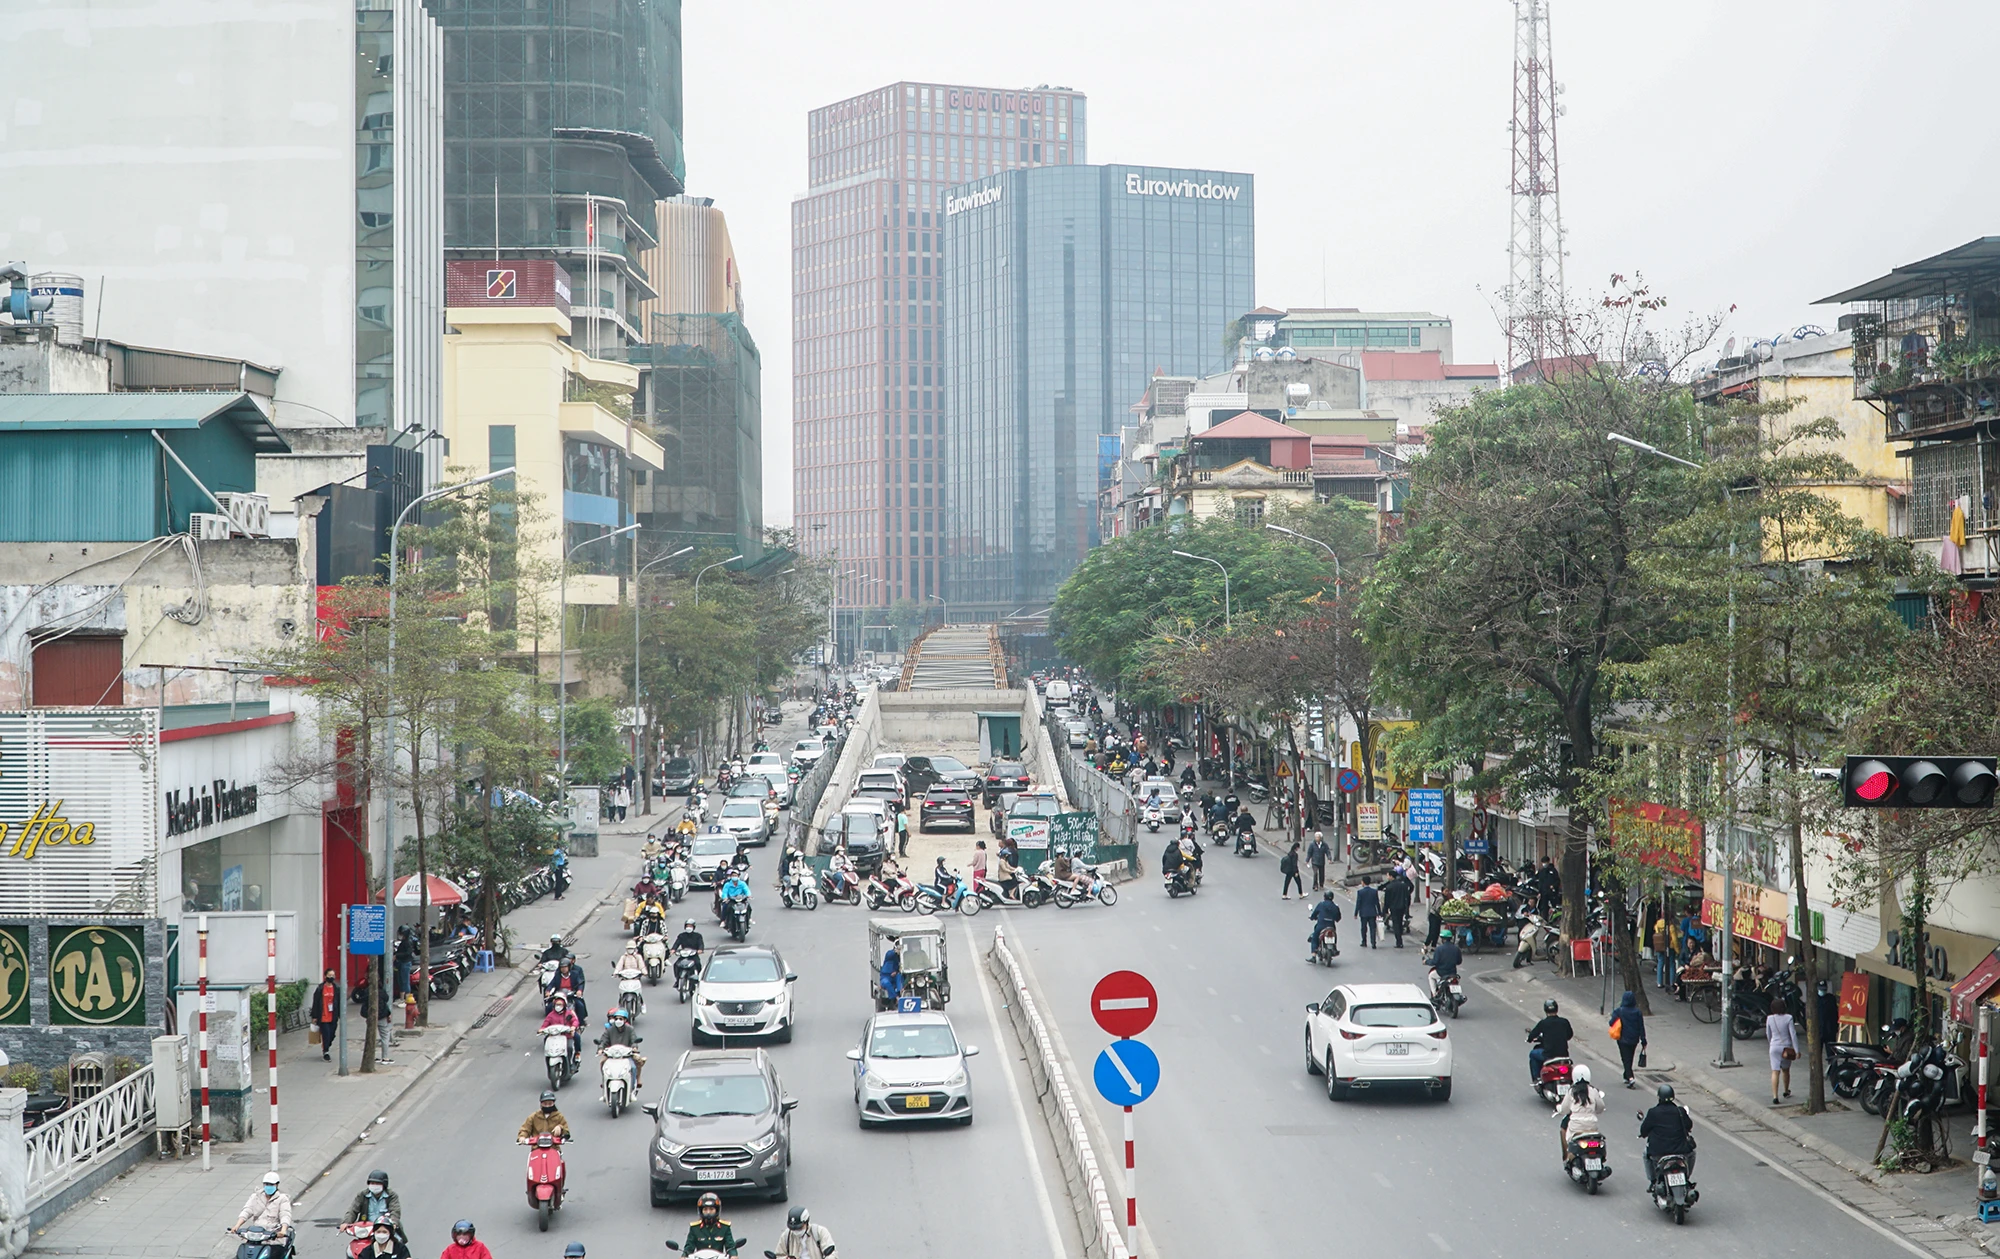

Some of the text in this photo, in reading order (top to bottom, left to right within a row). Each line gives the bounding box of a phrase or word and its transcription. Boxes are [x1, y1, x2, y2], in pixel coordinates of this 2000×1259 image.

[829, 97, 879, 126] CONINCO
[950, 91, 1042, 113] CONINCO
[946, 185, 1003, 217] Eurowindow
[1125, 173, 1240, 200] Eurowindow
[165, 778, 258, 838] Made in Vietnam
[9, 799, 96, 860] Hoa
